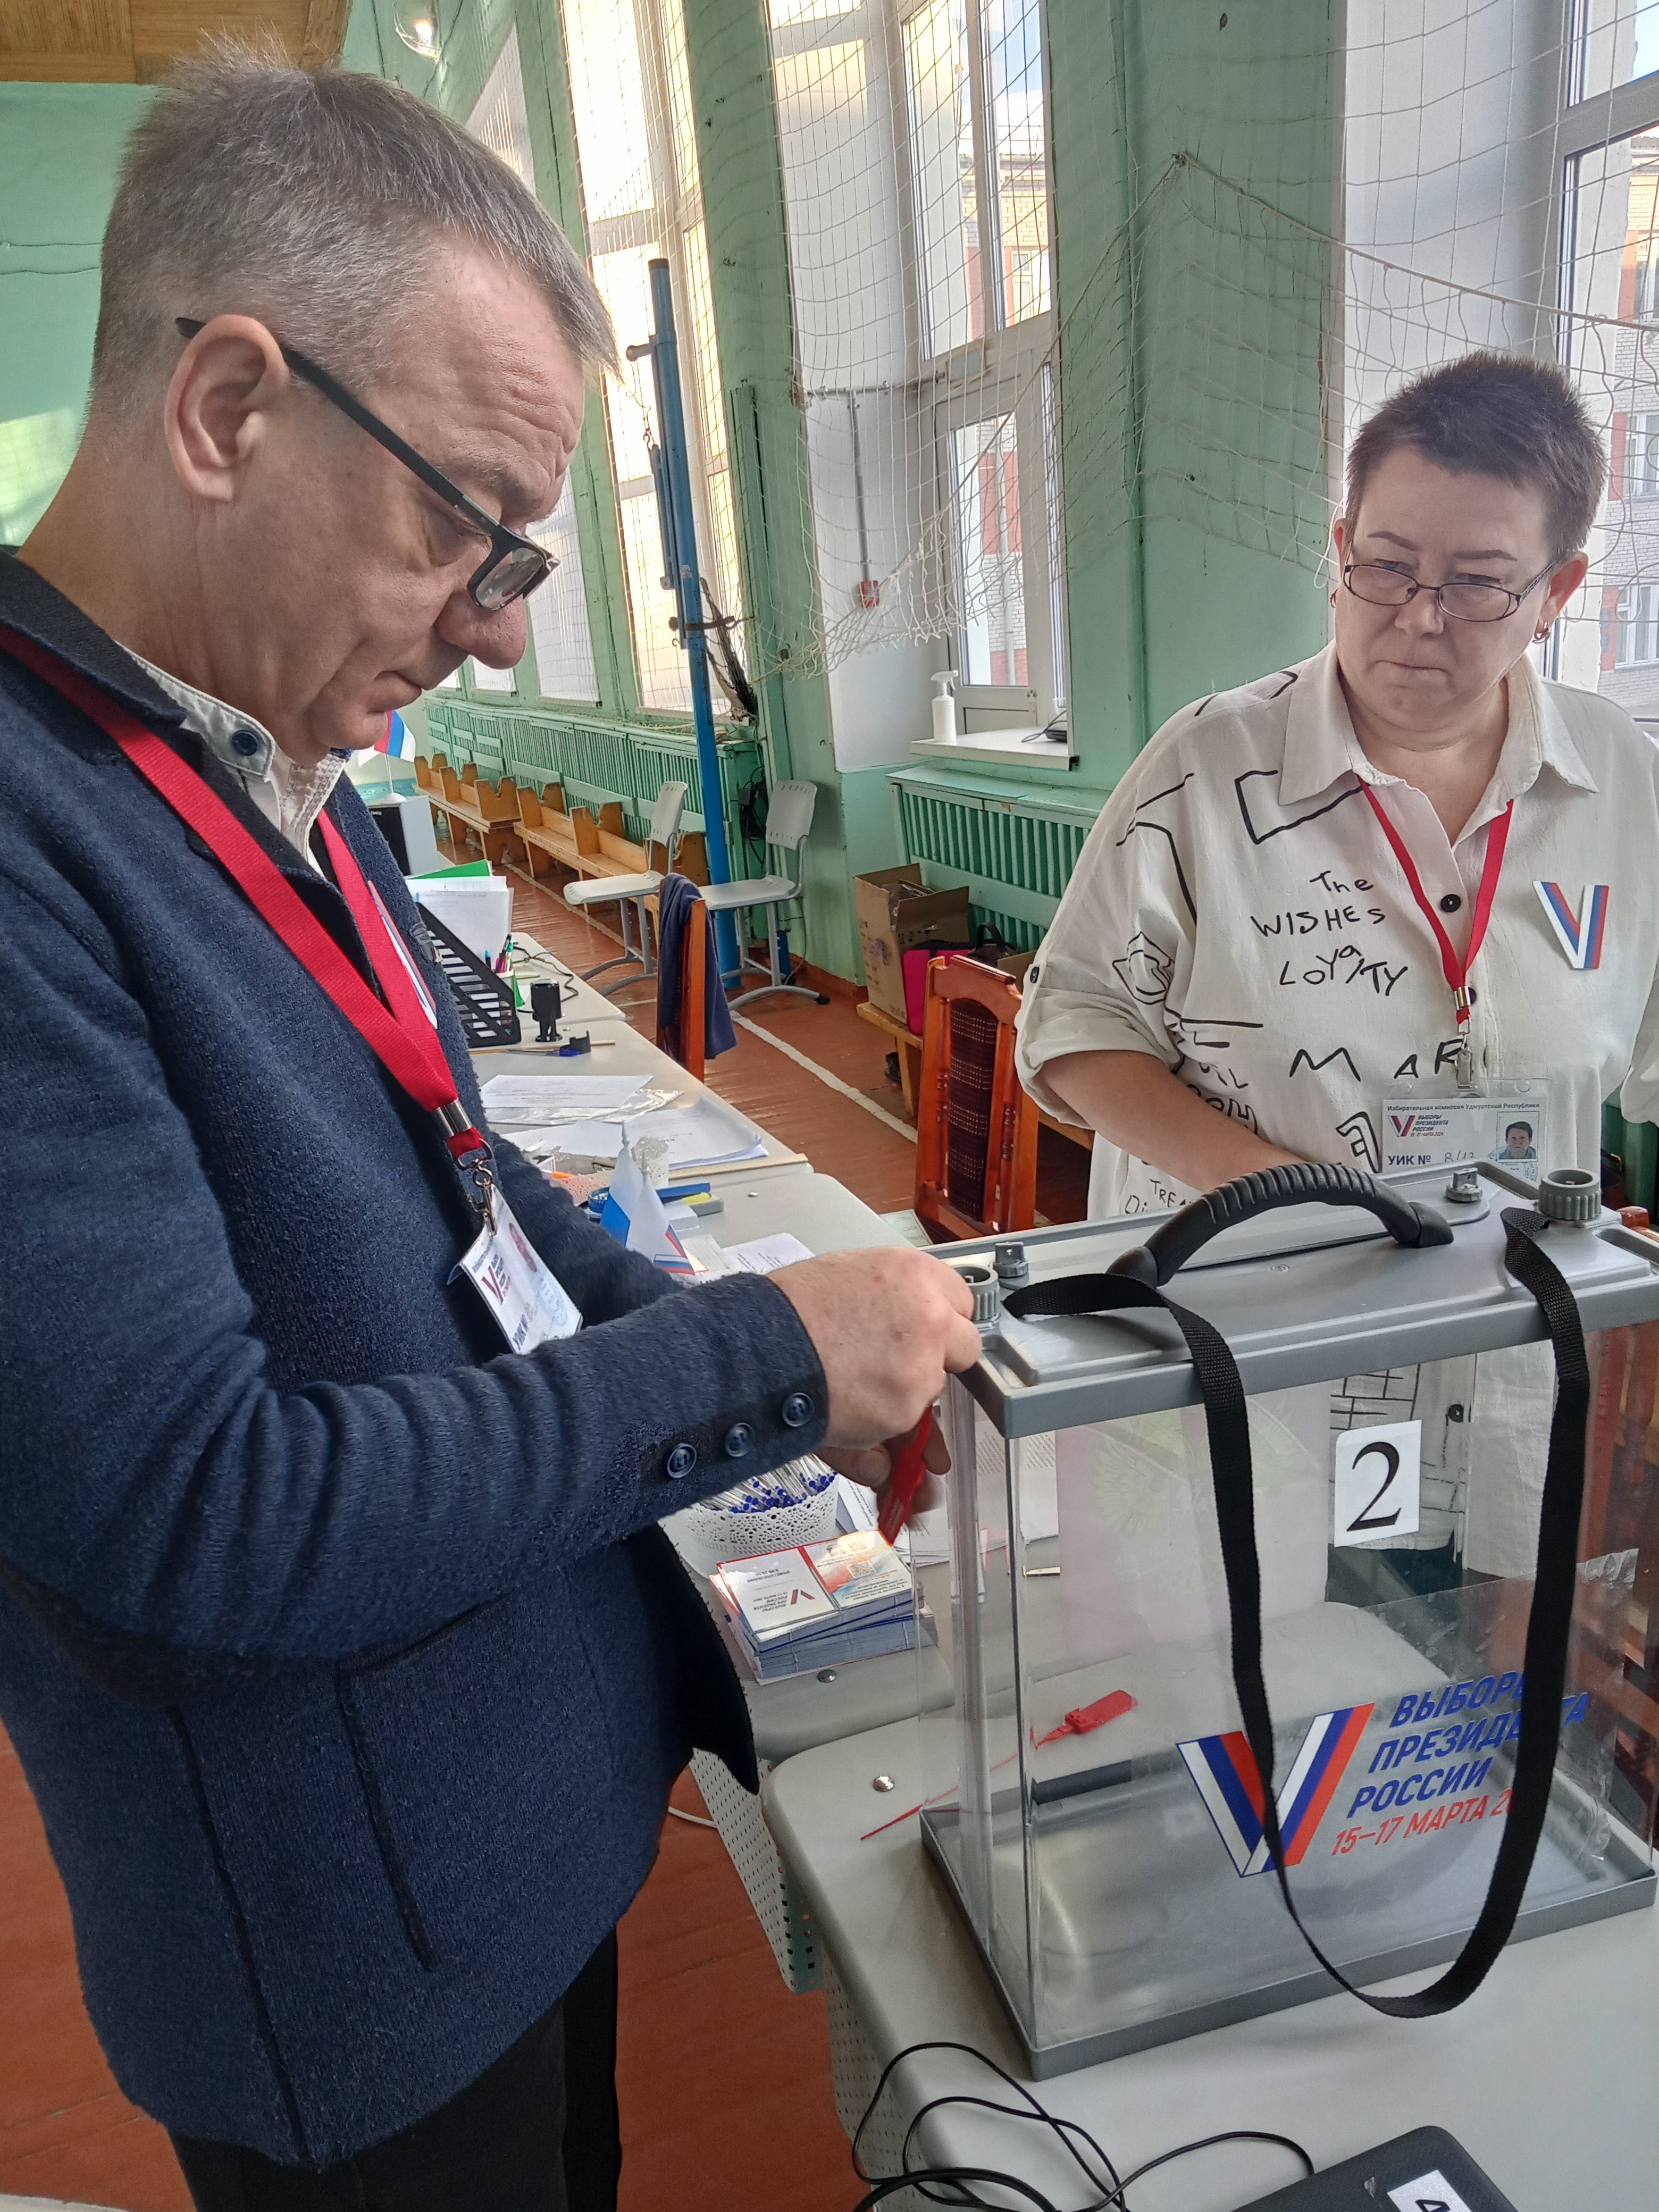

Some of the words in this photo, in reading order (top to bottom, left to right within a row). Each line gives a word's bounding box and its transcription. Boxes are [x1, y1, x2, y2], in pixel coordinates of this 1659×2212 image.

[1310, 870, 1374, 893] The
[1250, 905, 1386, 937] WISHES
[1388, 1155, 1414, 1166] УИК
[1346, 1440, 1402, 1532] 2
[1346, 1756, 1493, 1819] РОССИИ
[1403, 1795, 1489, 1839] МАРТА
